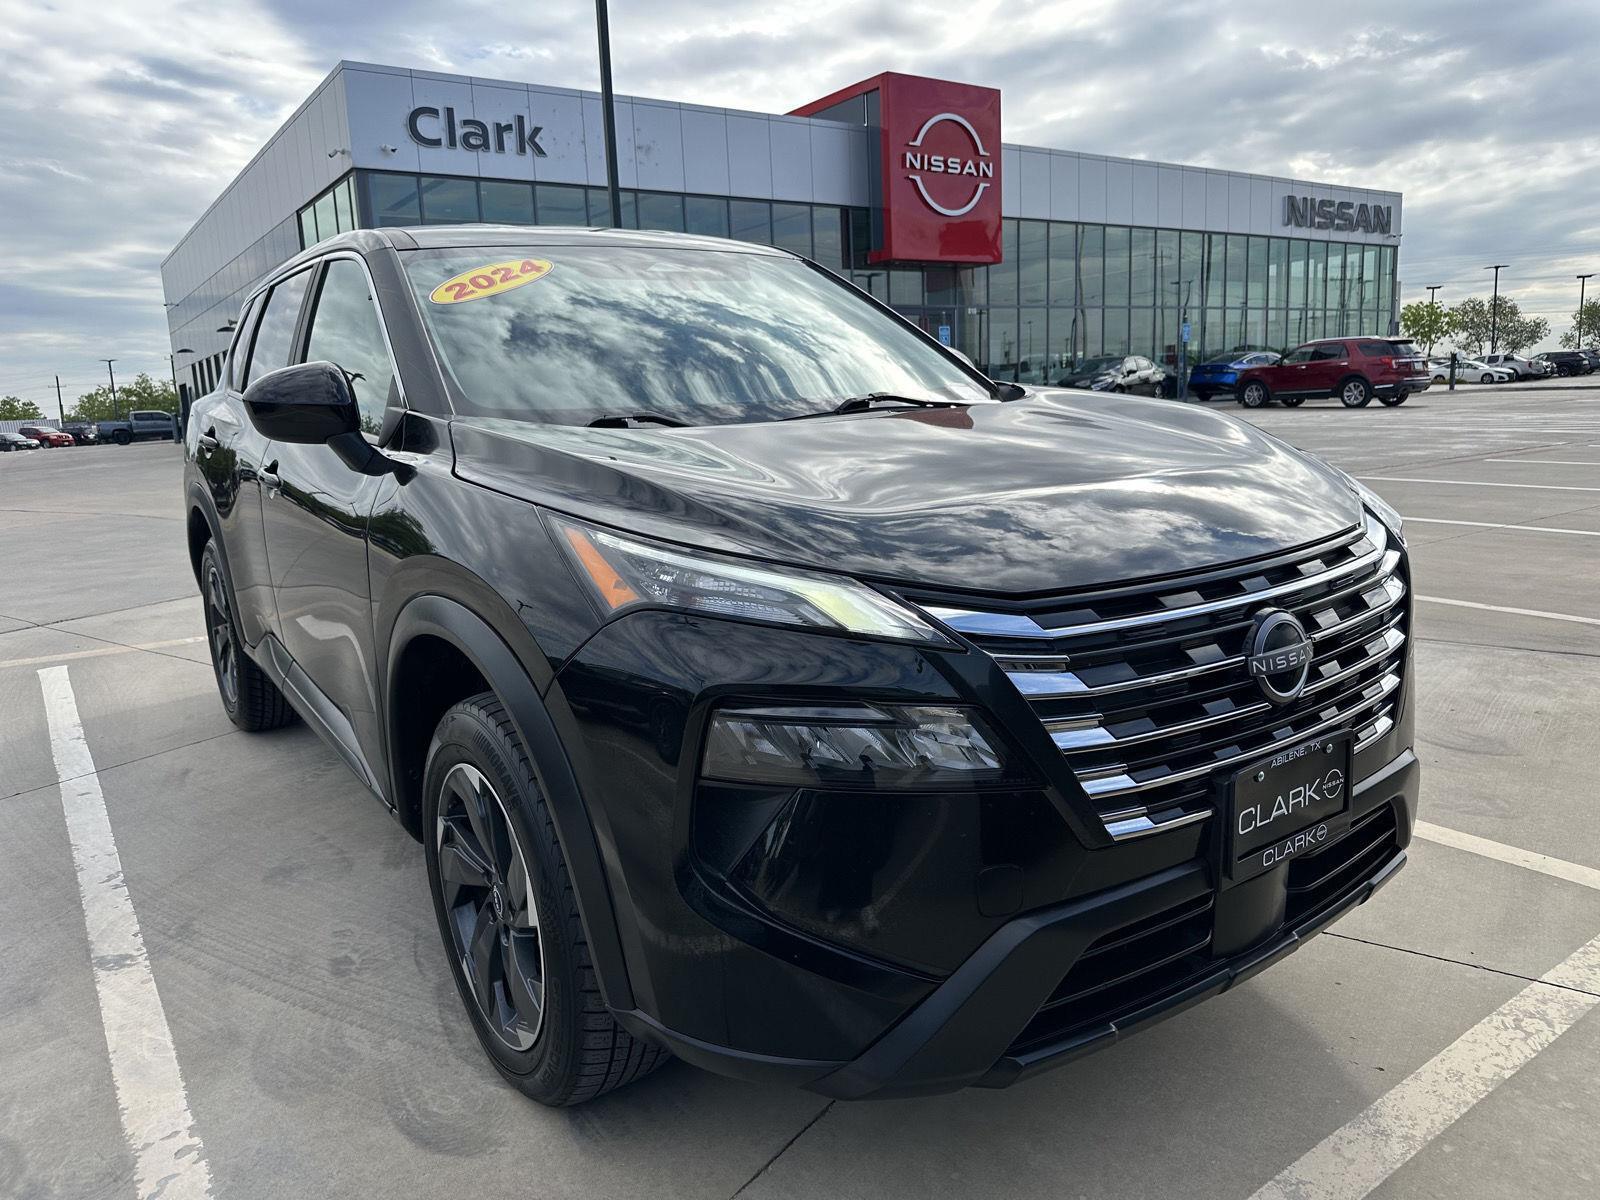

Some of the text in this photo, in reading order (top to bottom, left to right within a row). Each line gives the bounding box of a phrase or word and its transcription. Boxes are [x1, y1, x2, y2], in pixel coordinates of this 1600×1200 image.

[407, 106, 548, 157] Clark
[905, 151, 993, 178] NISSAN
[1284, 195, 1391, 234] NISSAN
[445, 260, 544, 300] 2024
[1310, 741, 1321, 752] TX
[1322, 778, 1344, 790] NISSAN
[1238, 778, 1321, 835] CLARK
[1263, 829, 1316, 866] CLARK
